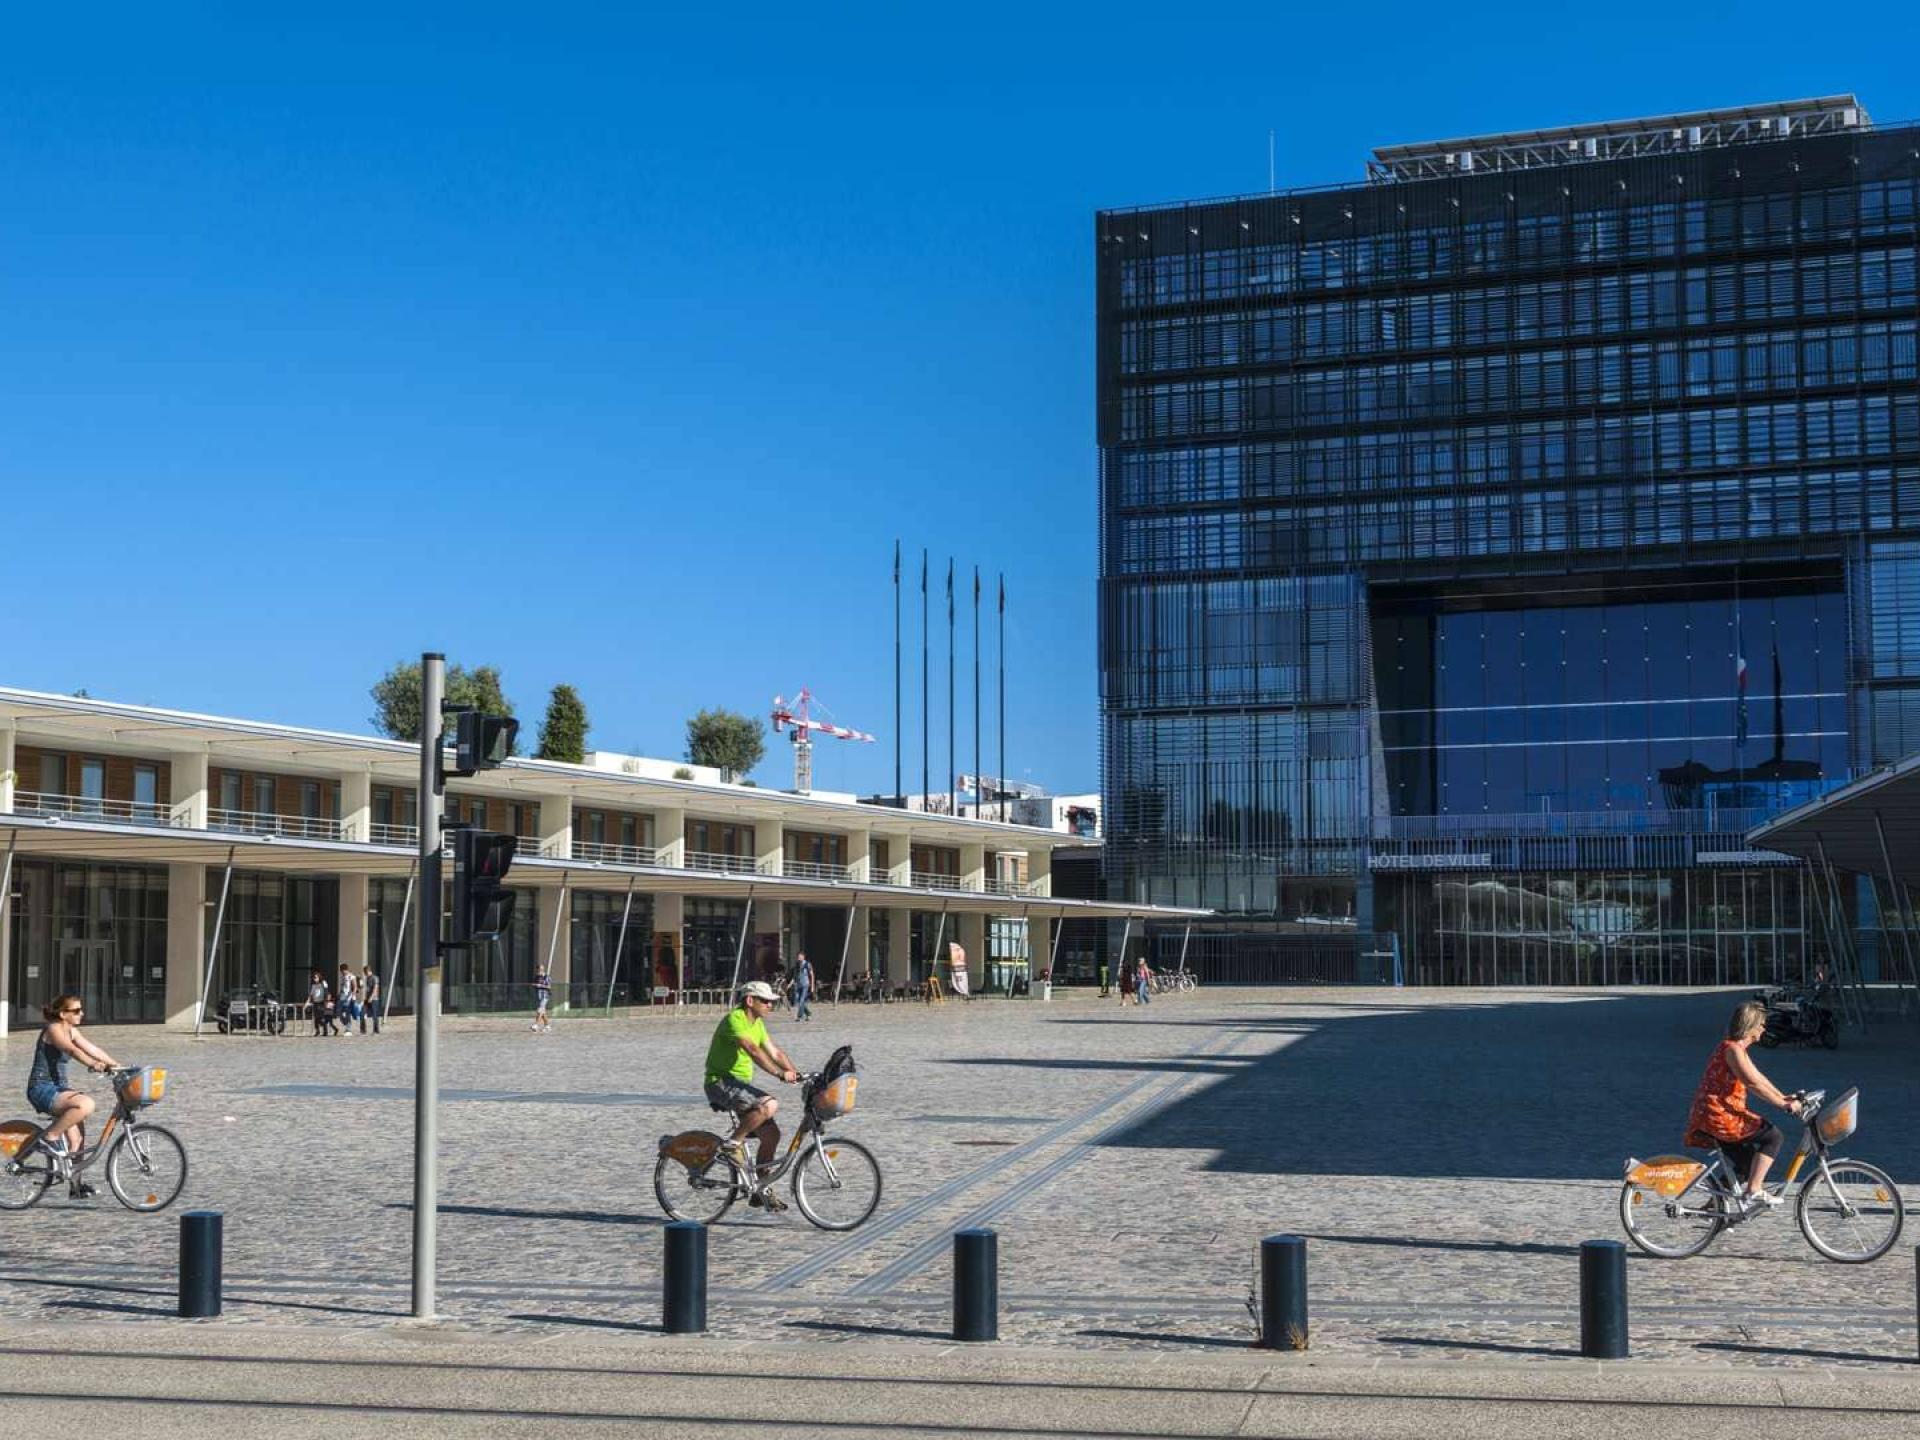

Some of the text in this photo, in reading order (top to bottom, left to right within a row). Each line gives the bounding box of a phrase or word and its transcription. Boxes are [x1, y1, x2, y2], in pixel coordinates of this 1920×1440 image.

[1368, 852, 1491, 868] HÔTEL DE VILLE
